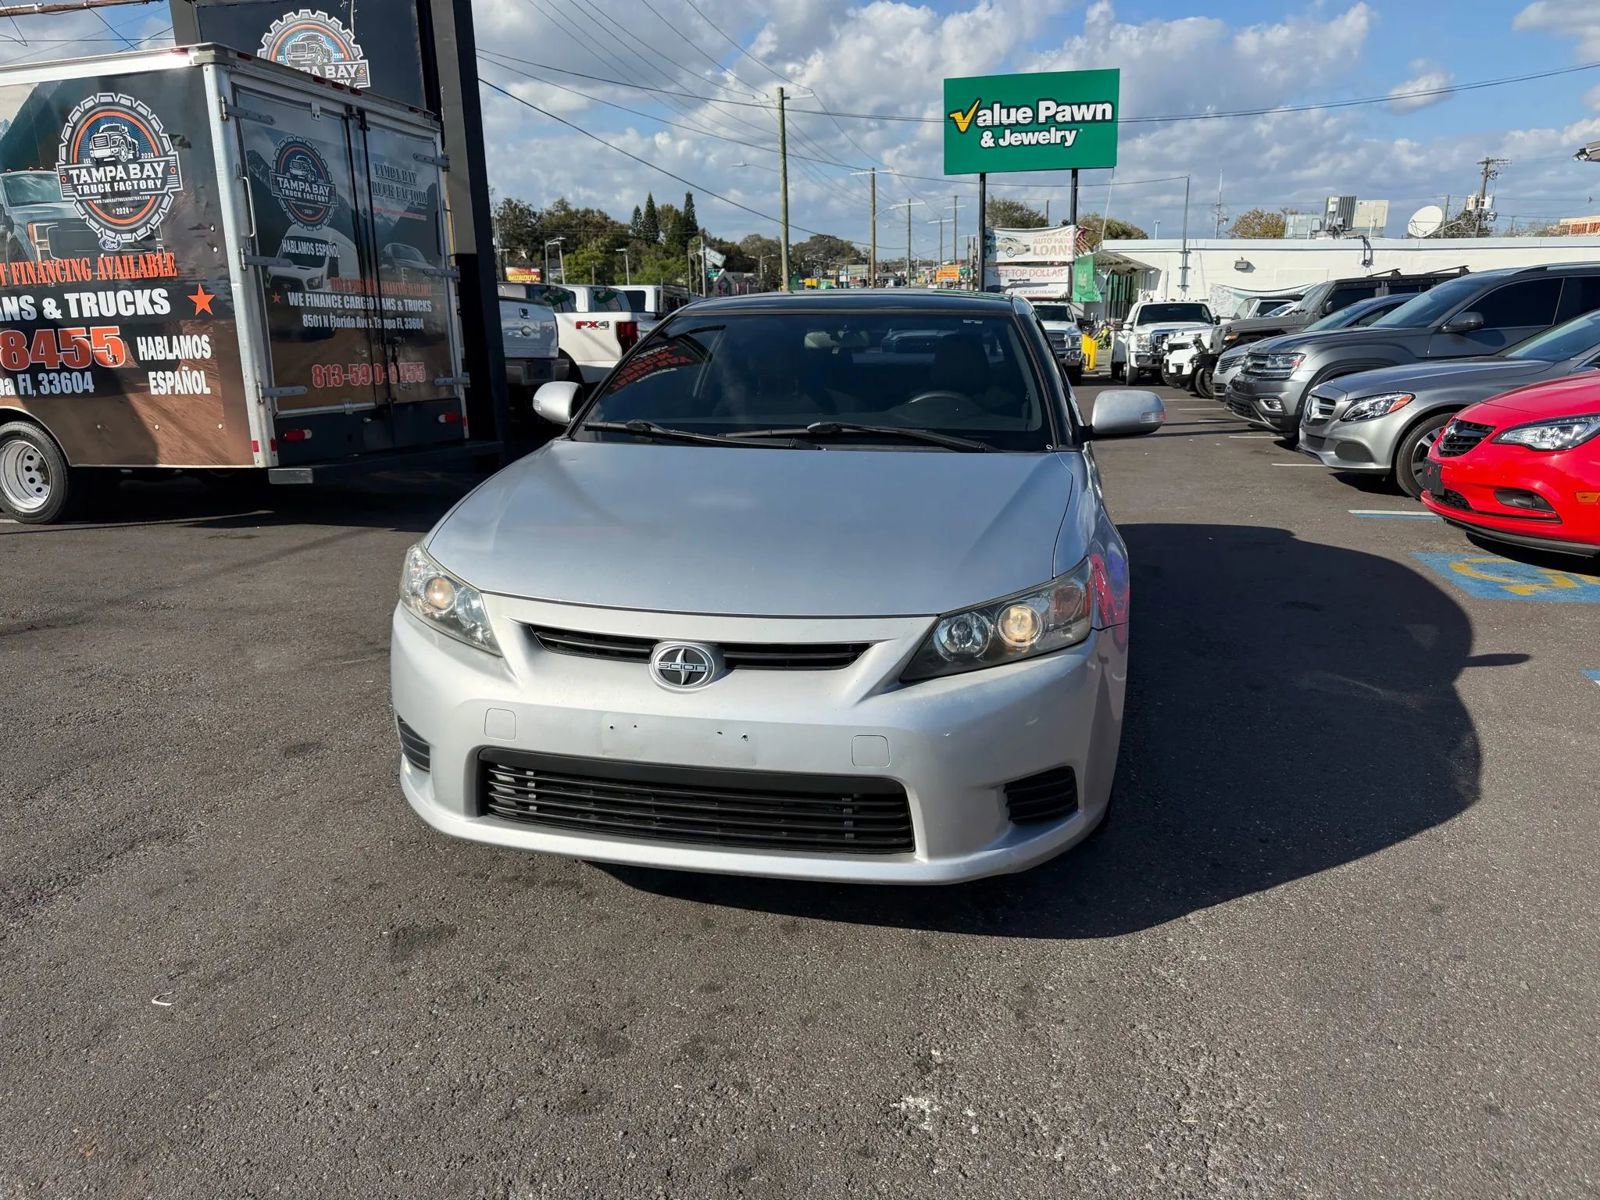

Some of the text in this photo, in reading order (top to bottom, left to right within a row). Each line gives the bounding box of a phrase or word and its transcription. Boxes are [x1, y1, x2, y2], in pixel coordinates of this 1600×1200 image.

[324, 64, 358, 79] BAY
[1037, 100, 1113, 124] Pawn
[980, 127, 1077, 148] & Jewelry
[68, 162, 166, 185] TAMPA BAY
[76, 179, 162, 195] TRUCK FACTORY
[276, 177, 331, 197] TAMPA BAY
[10, 256, 92, 286] FINANCING
[97, 252, 178, 281] AVAILABLE
[42, 298, 63, 320] &
[64, 288, 171, 318] TRUCKS
[287, 292, 304, 307] WE
[305, 292, 343, 309] FINANCE
[397, 300, 404, 312] &
[403, 298, 432, 313] TRUCKS
[302, 313, 322, 328] 8501
[322, 315, 329, 328] N
[575, 320, 609, 330] FX4
[136, 334, 212, 361] HABLAMOS
[38, 371, 95, 395] 33604
[148, 366, 211, 396] ESPAÑOL
